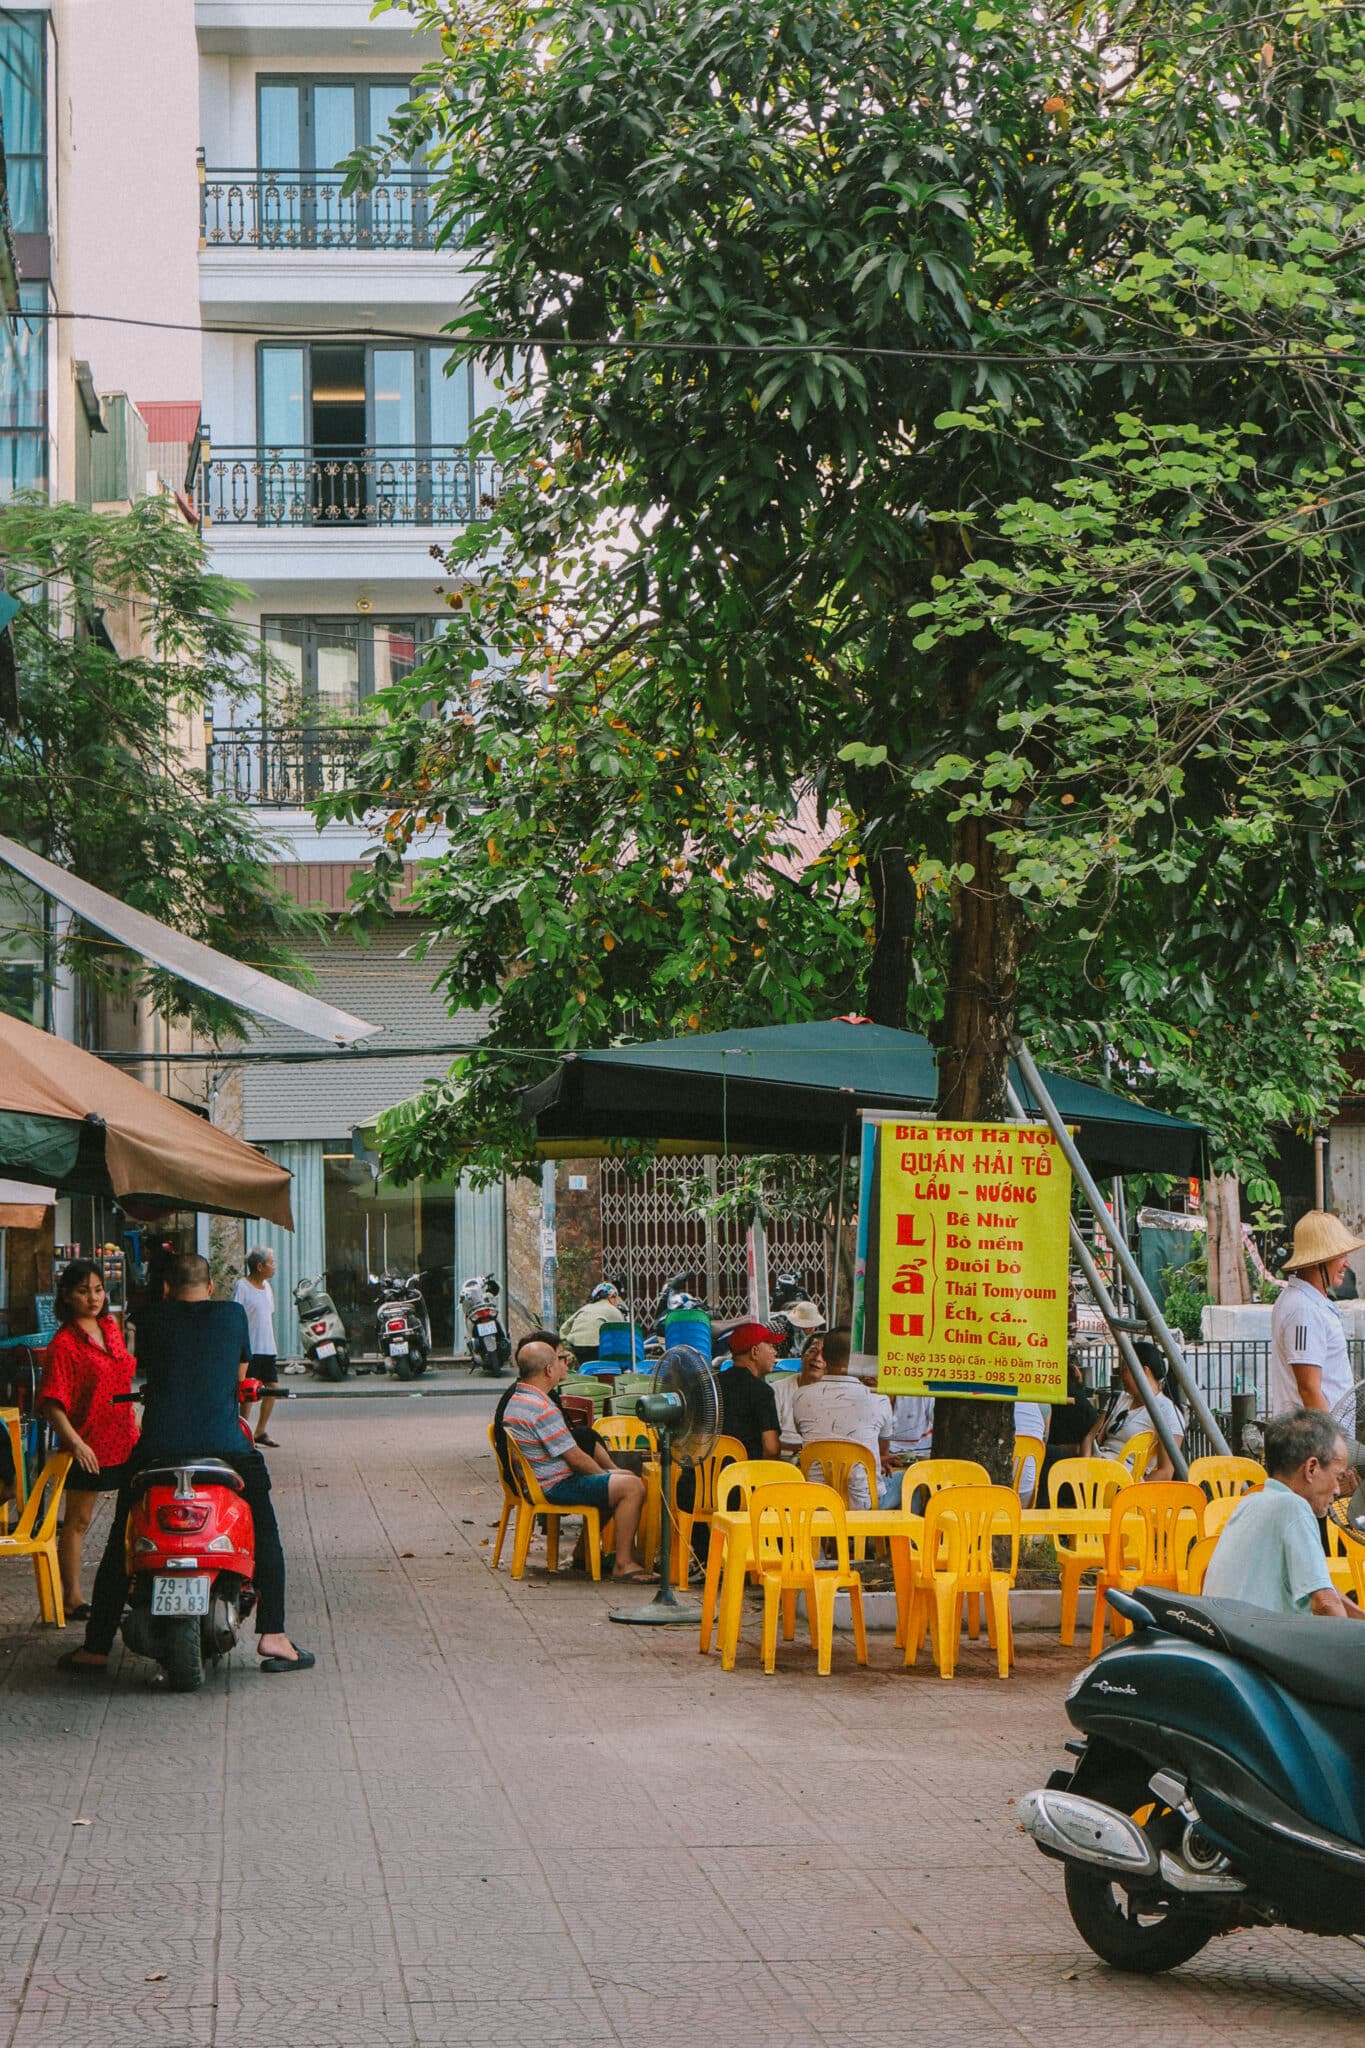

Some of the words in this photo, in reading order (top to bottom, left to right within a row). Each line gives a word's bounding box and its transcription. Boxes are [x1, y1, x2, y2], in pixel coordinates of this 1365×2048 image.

[901, 1148, 964, 1176] QUÁN
[972, 1149, 1013, 1175] HẢI
[915, 1173, 950, 1201] LẨU
[976, 1181, 1037, 1204] NƯỚNG
[947, 1211, 970, 1226] Bê
[946, 1234, 971, 1249] Bò
[978, 1235, 1024, 1251] mềm
[945, 1257, 990, 1273] Đuôi
[996, 1259, 1022, 1274] bò
[945, 1280, 977, 1297] Thái
[982, 1282, 1057, 1301] Tomyoum
[944, 1328, 983, 1345] Chim
[987, 1331, 1022, 1348] Câu,
[1026, 1332, 1049, 1348] Gà
[887, 1351, 904, 1361] ĐC:
[906, 1352, 926, 1364] Ngõ
[928, 1353, 946, 1363] 135
[948, 1354, 966, 1366] Đội
[1010, 1358, 1034, 1369] Đầm
[883, 1365, 901, 1377] ĐT:
[904, 1366, 924, 1378] 035
[926, 1368, 947, 1379] 774
[949, 1369, 976, 1381] 3533
[985, 1370, 1006, 1383] 098
[1008, 1372, 1015, 1383] 5
[1018, 1373, 1032, 1384] 20
[1034, 1373, 1062, 1386] 8786
[1166, 1609, 1216, 1637] Grande
